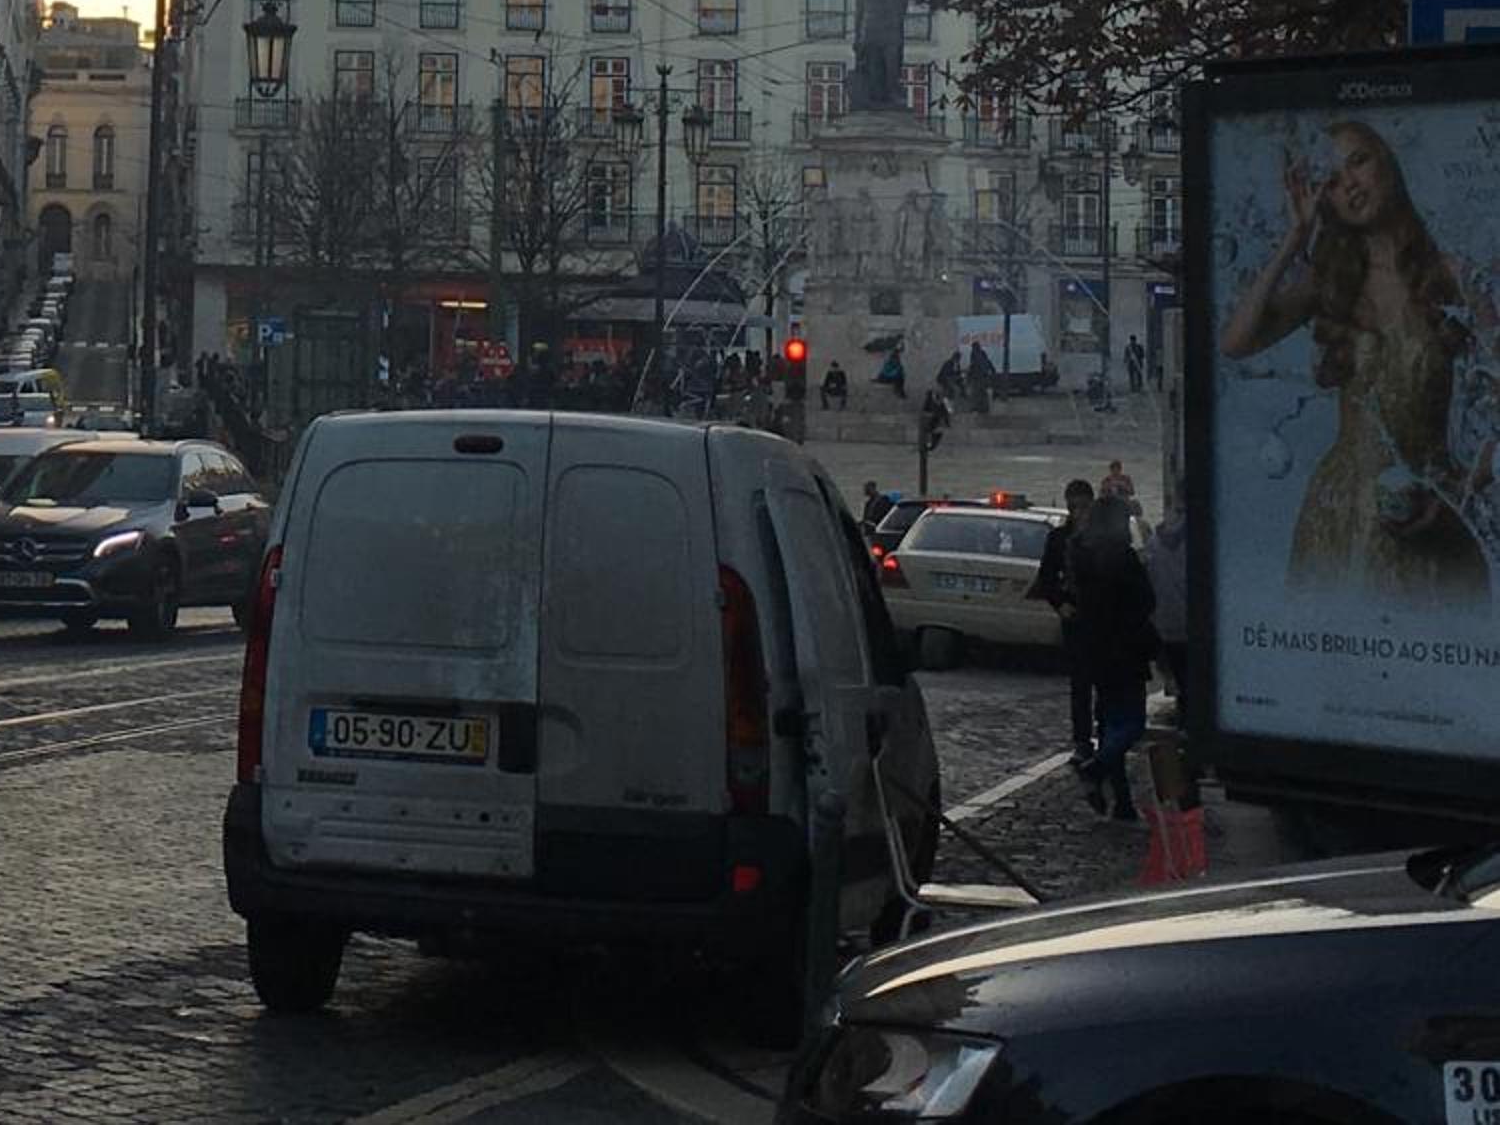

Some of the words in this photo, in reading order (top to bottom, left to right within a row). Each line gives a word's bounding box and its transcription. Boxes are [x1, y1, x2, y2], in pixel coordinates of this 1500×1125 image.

[258, 324, 273, 343] P
[1242, 621, 1268, 648] DÊ
[1271, 631, 1318, 652] MAIS
[1321, 633, 1395, 659] BRILHO
[1398, 640, 1428, 662] AO
[1430, 641, 1471, 666] SEU
